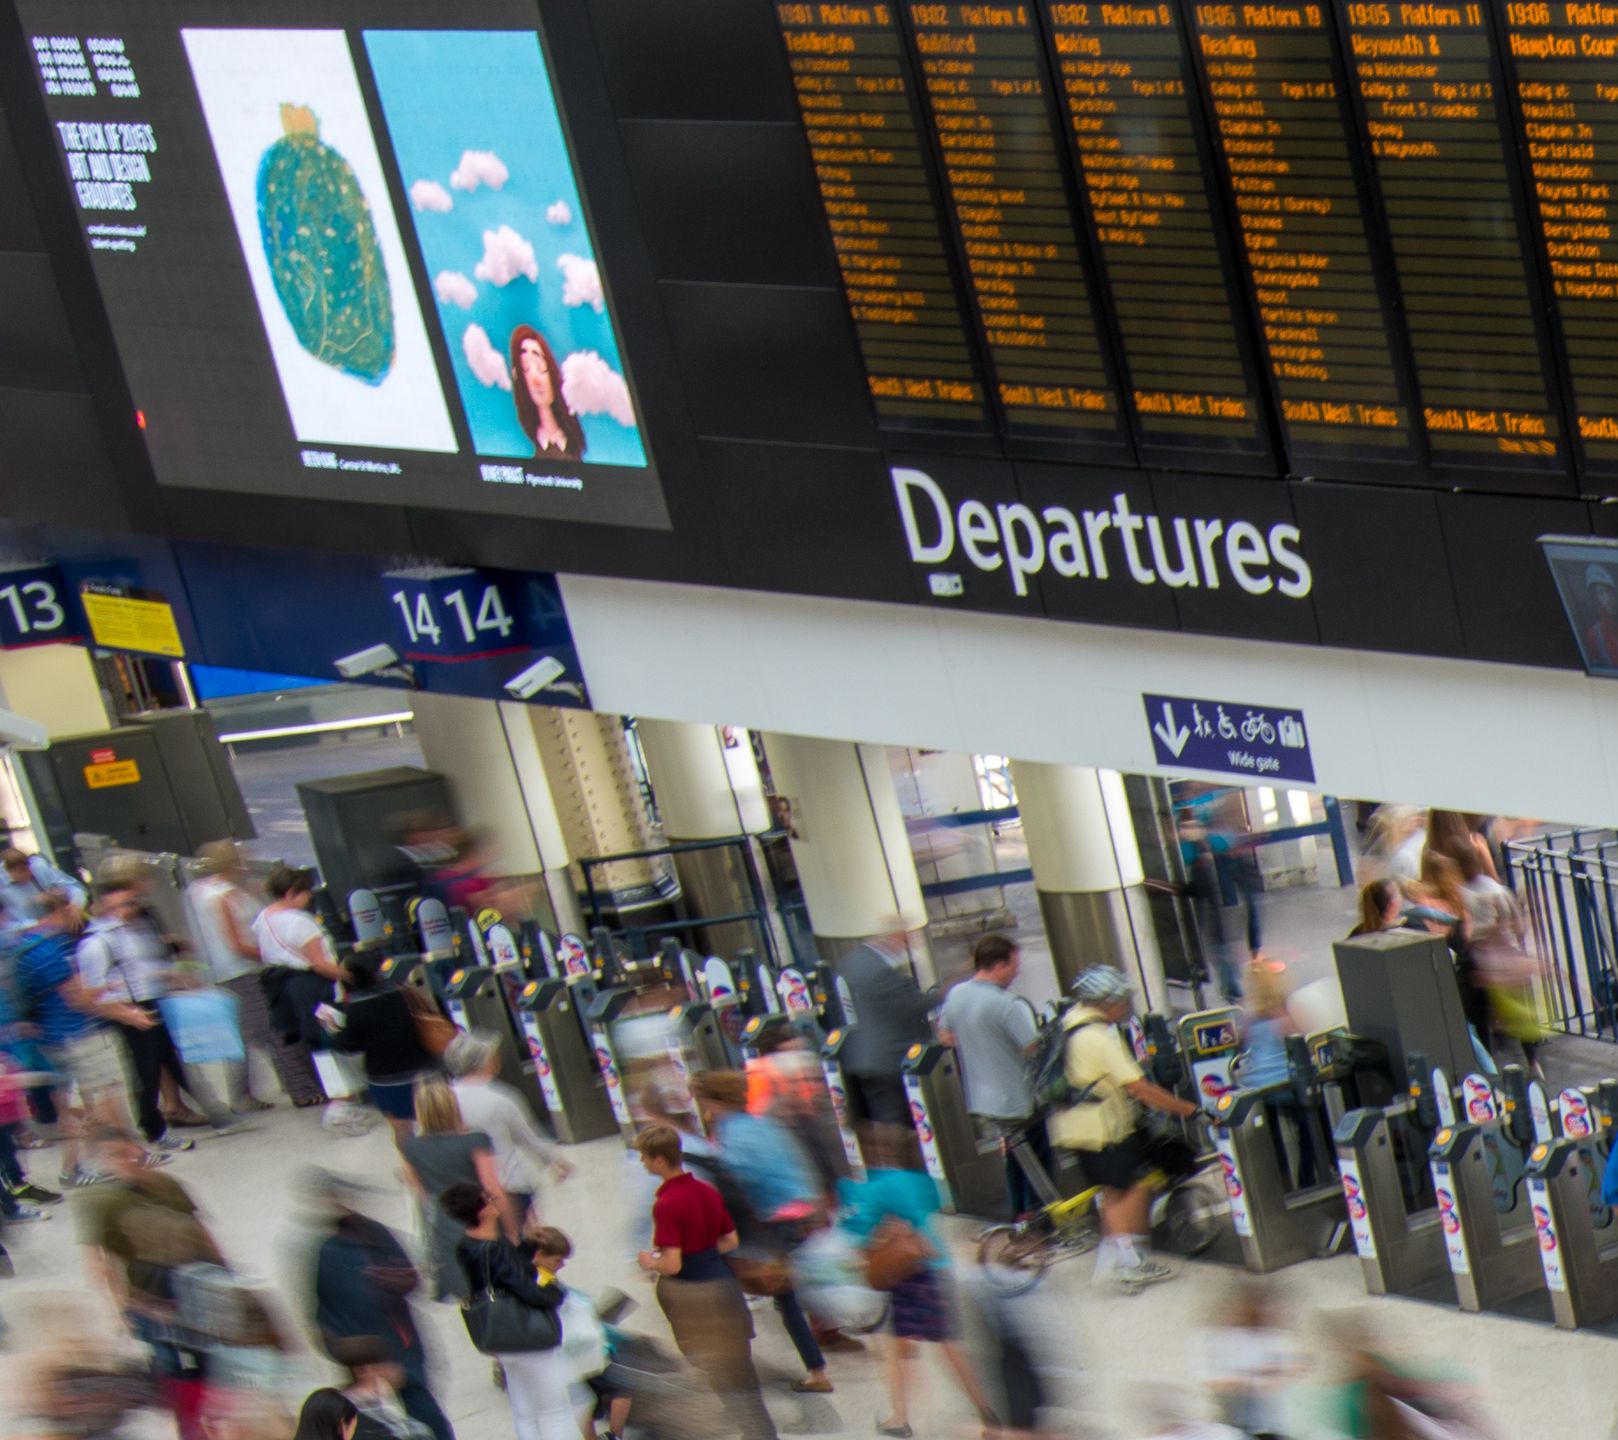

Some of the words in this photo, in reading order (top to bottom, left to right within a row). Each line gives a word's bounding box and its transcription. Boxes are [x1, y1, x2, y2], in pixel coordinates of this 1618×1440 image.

[1507, 1, 1552, 26] 19:06
[1510, 33, 1578, 59] Hampton
[891, 467, 1312, 597] Departures
[0, 581, 63, 633] 13
[393, 590, 441, 644] 14
[444, 585, 514, 640] 14
[1227, 750, 1255, 768] Wide
[1256, 756, 1280, 772] gate
